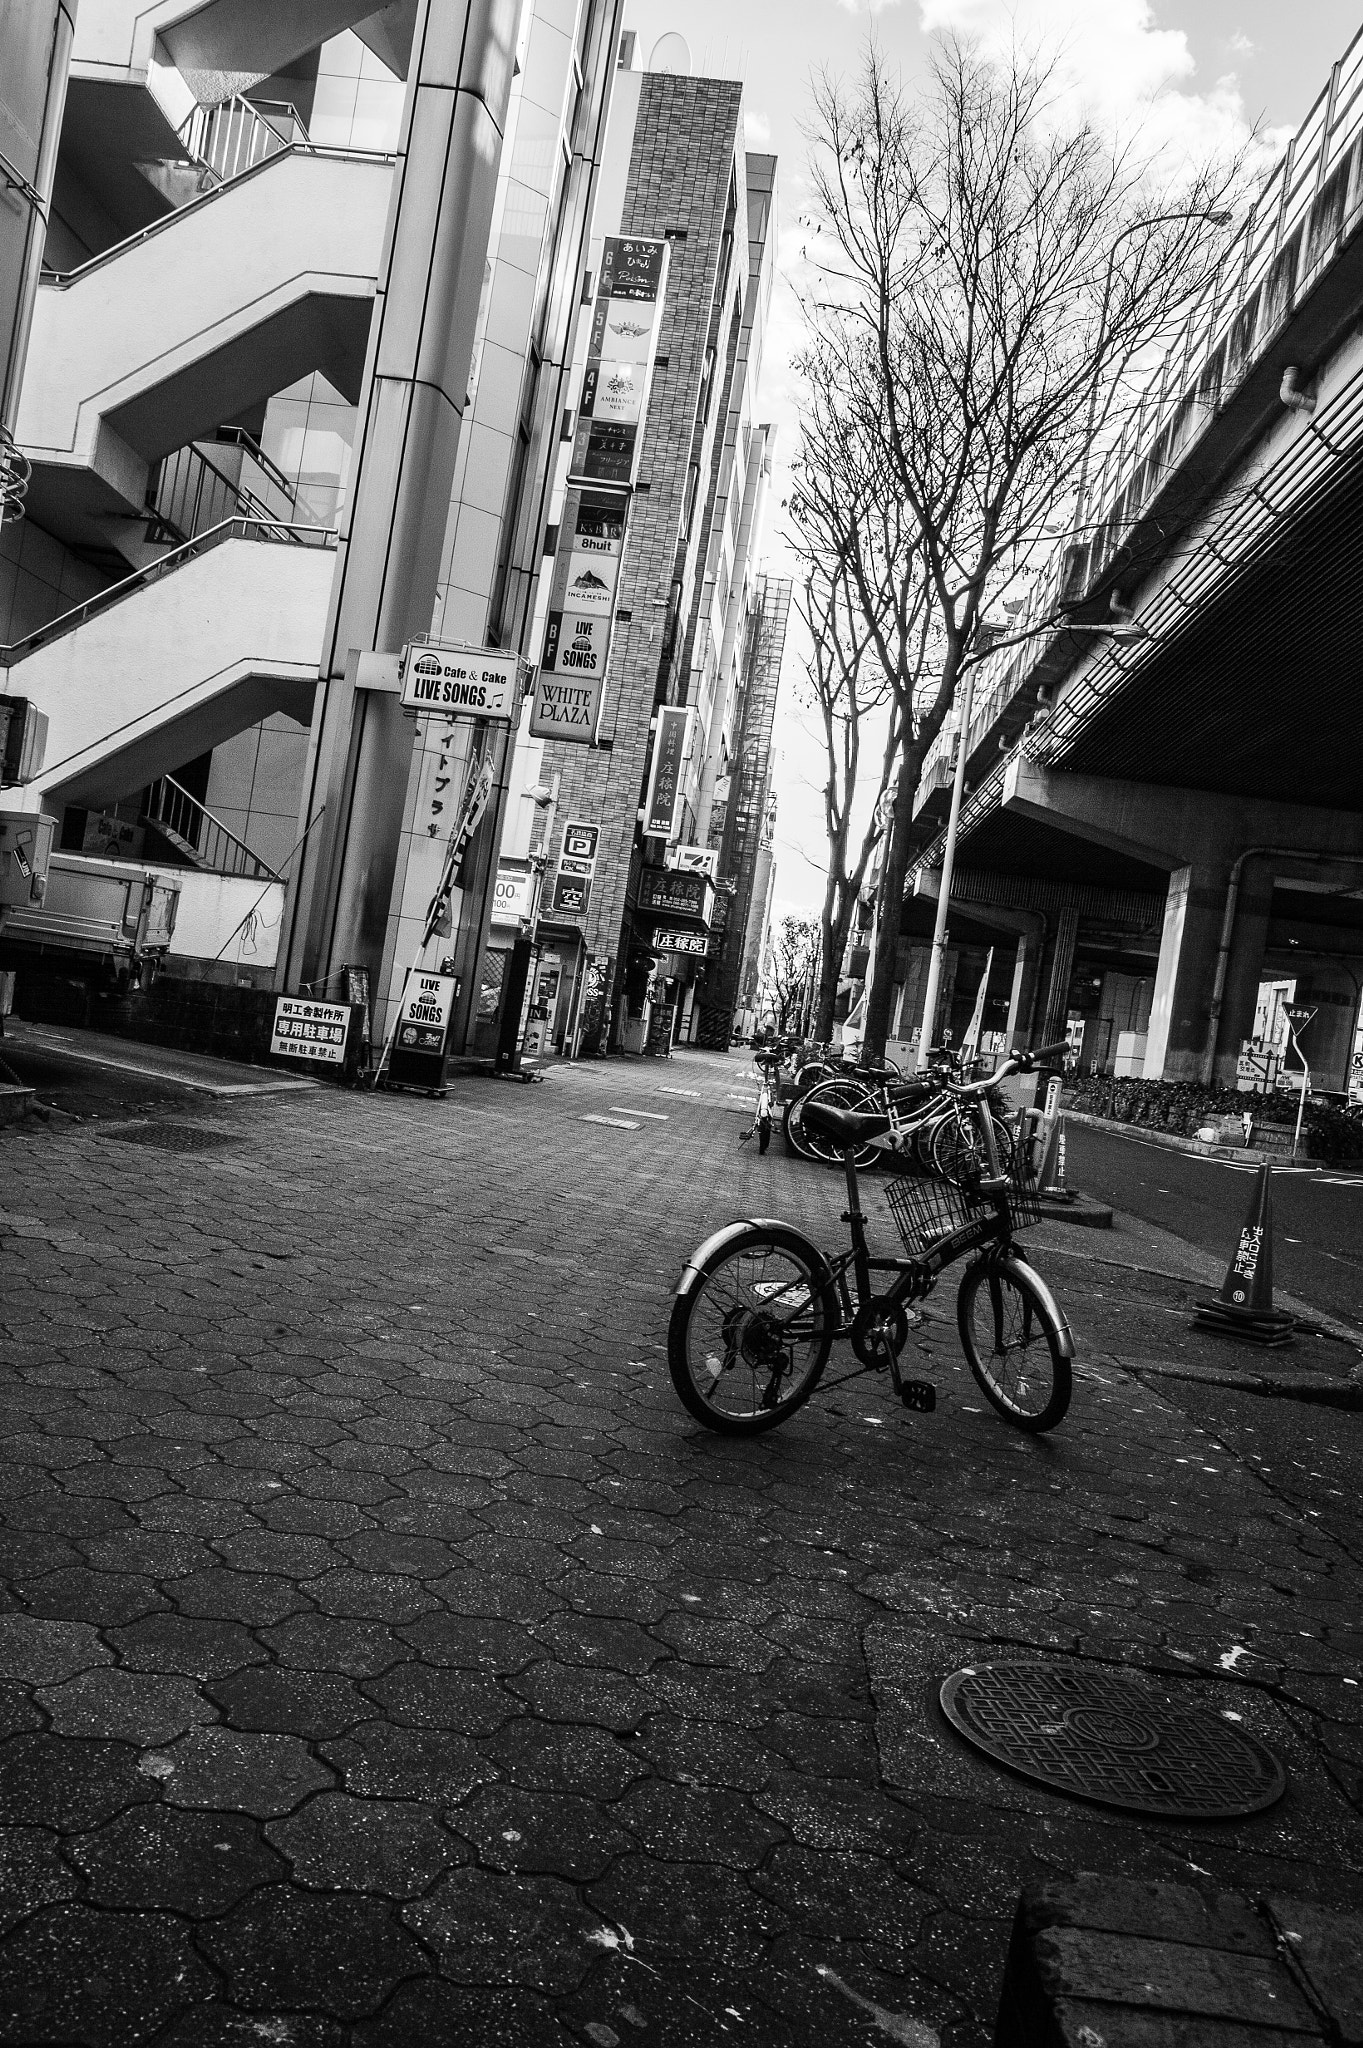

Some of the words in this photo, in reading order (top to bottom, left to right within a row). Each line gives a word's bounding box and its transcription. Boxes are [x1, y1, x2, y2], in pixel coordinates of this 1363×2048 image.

[582, 538, 612, 551] 8huit
[568, 592, 610, 602] INCAMESHI
[575, 621, 593, 635] LIVE
[562, 649, 598, 670] SONGS
[444, 666, 467, 679] Cafe
[469, 671, 478, 680] &
[481, 671, 507, 684] Cake
[413, 678, 441, 701] LIVE
[442, 681, 487, 707] SONGS
[542, 684, 592, 707] WHITE
[539, 702, 591, 726] PLAZA
[572, 840, 586, 852] P
[560, 887, 583, 911] 空
[420, 978, 441, 992] LIVE
[408, 1002, 443, 1023] SONGS
[1288, 1009, 1310, 1019] 止まれ
[277, 1020, 343, 1043] 専用駐車場
[278, 1040, 337, 1059] 無断駐車禁止
